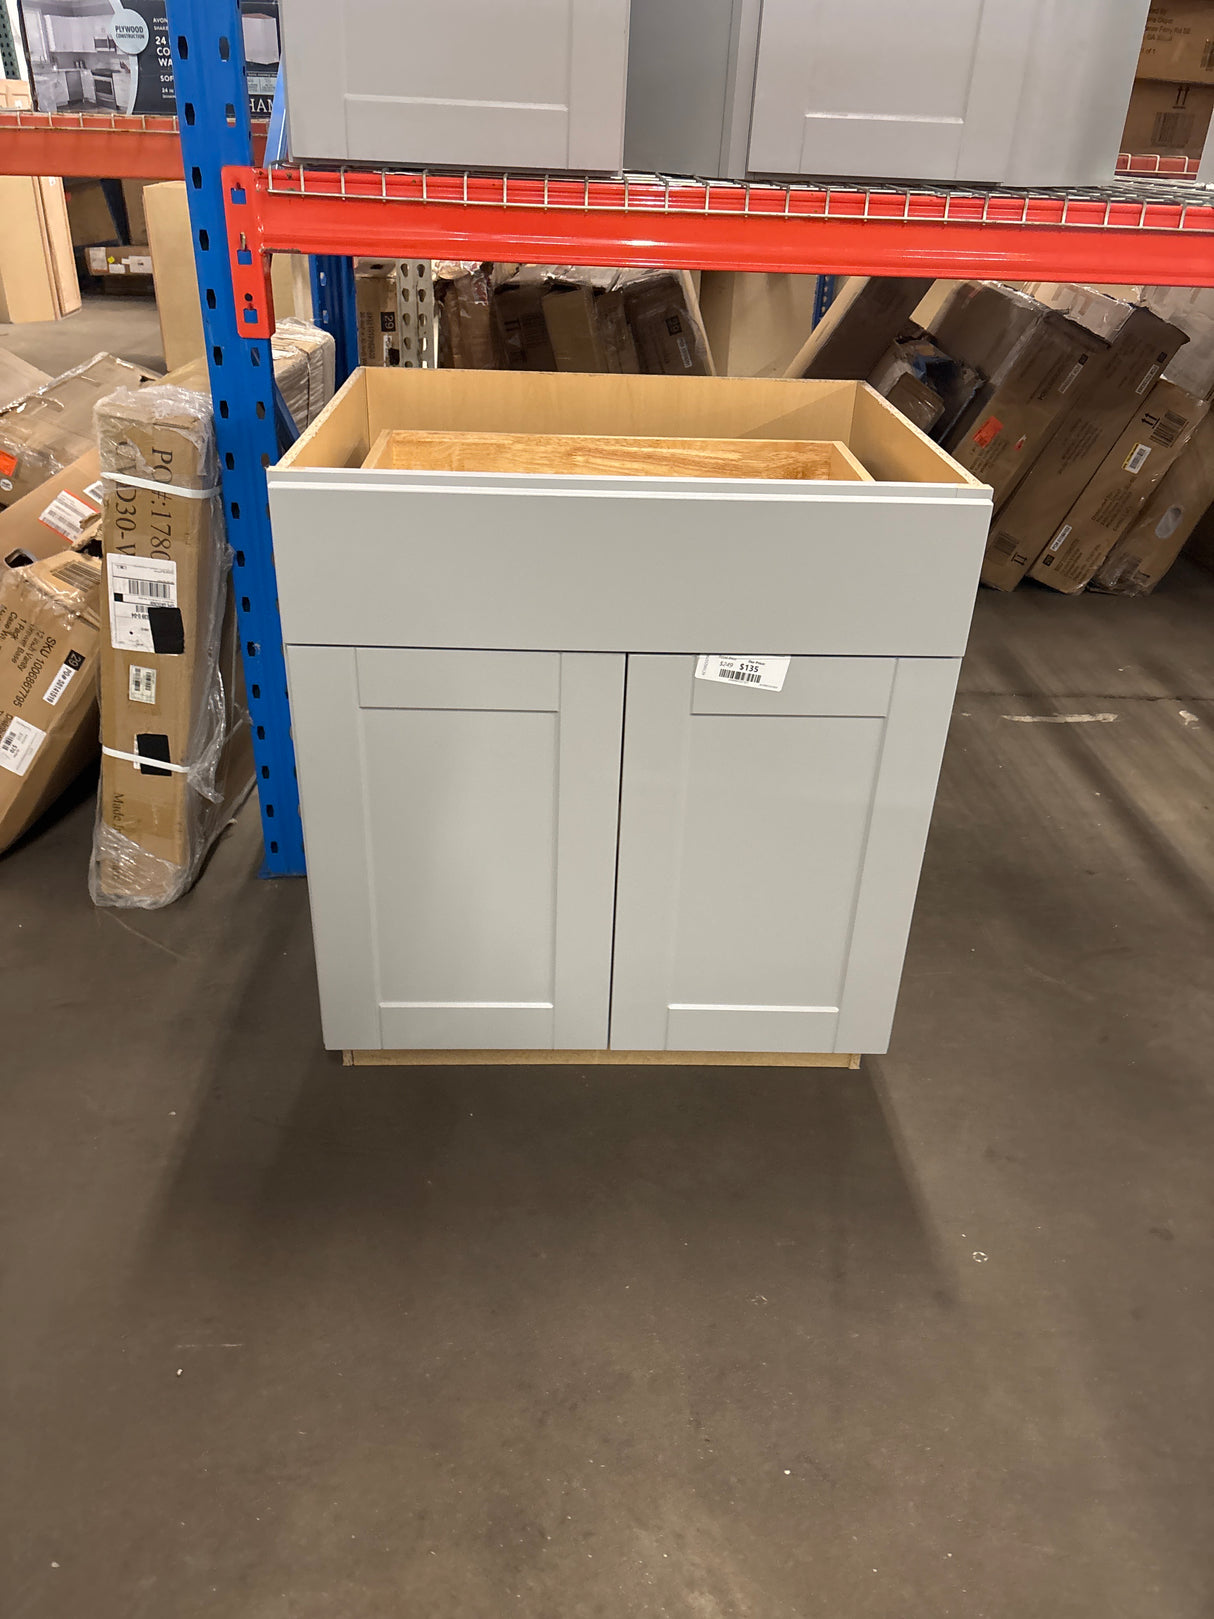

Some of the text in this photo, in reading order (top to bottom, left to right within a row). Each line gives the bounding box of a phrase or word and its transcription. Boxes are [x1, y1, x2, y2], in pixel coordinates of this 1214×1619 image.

[114, 25, 144, 34] PLYWOOD
[155, 36, 166, 45] 24
[156, 47, 170, 56] CO
[384, 315, 395, 330] 29
[4, 611, 18, 630] Case
[40, 636, 56, 660] SKU
[68, 652, 82, 666] 29
[740, 664, 759, 672] $135
[13, 660, 45, 708] 1006867795
[112, 793, 124, 822] Made
